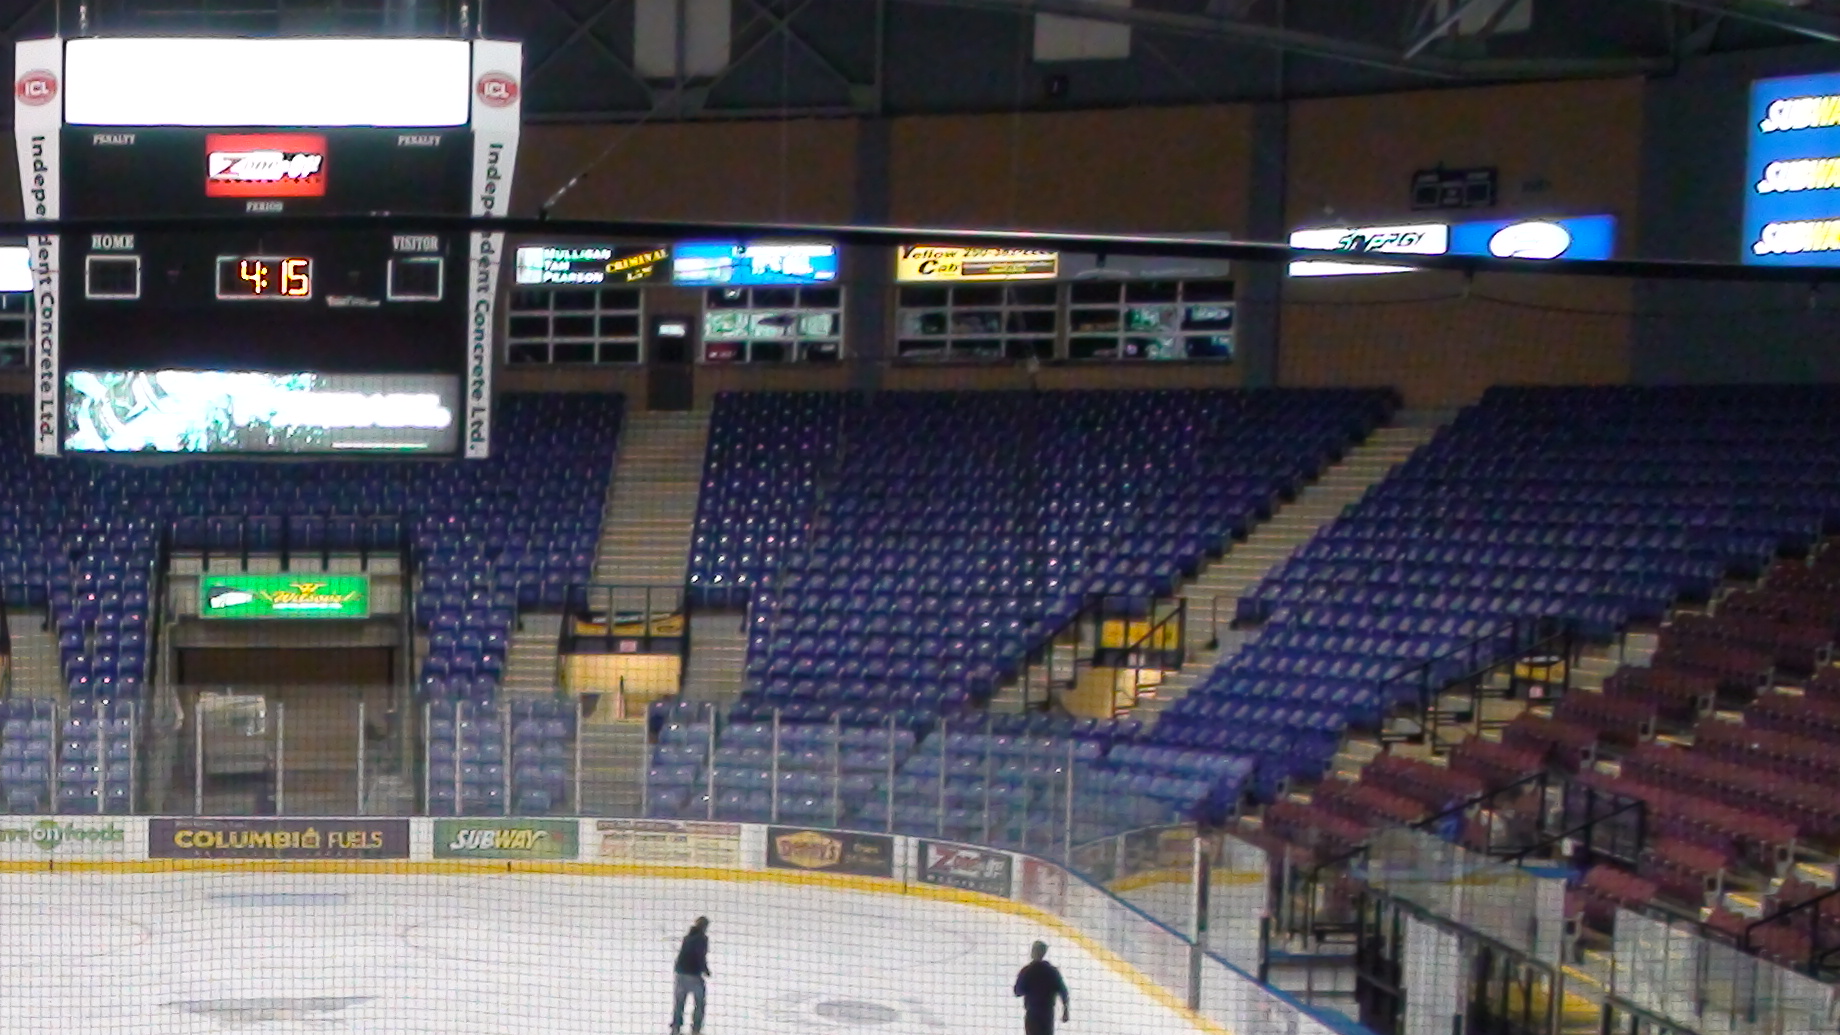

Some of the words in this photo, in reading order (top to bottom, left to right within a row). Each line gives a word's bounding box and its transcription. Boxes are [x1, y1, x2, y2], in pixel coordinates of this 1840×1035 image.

[24, 80, 50, 96] ICL
[93, 134, 136, 146] PENALTY
[398, 135, 441, 147] PENALTY
[31, 135, 52, 285] Indepedent
[91, 234, 135, 250] HOME
[392, 235, 439, 251] VISITOR
[238, 258, 310, 297] 4:15
[918, 259, 960, 275] Cab
[40, 292, 55, 394] Concrete
[472, 299, 490, 400] Concrete
[40, 400, 54, 443] Ltd.
[469, 407, 486, 451] Ltd.
[33, 828, 60, 841] on
[174, 826, 321, 849] COLUMBIA
[328, 830, 383, 849] FUELS
[449, 828, 549, 852] SUBWAY
